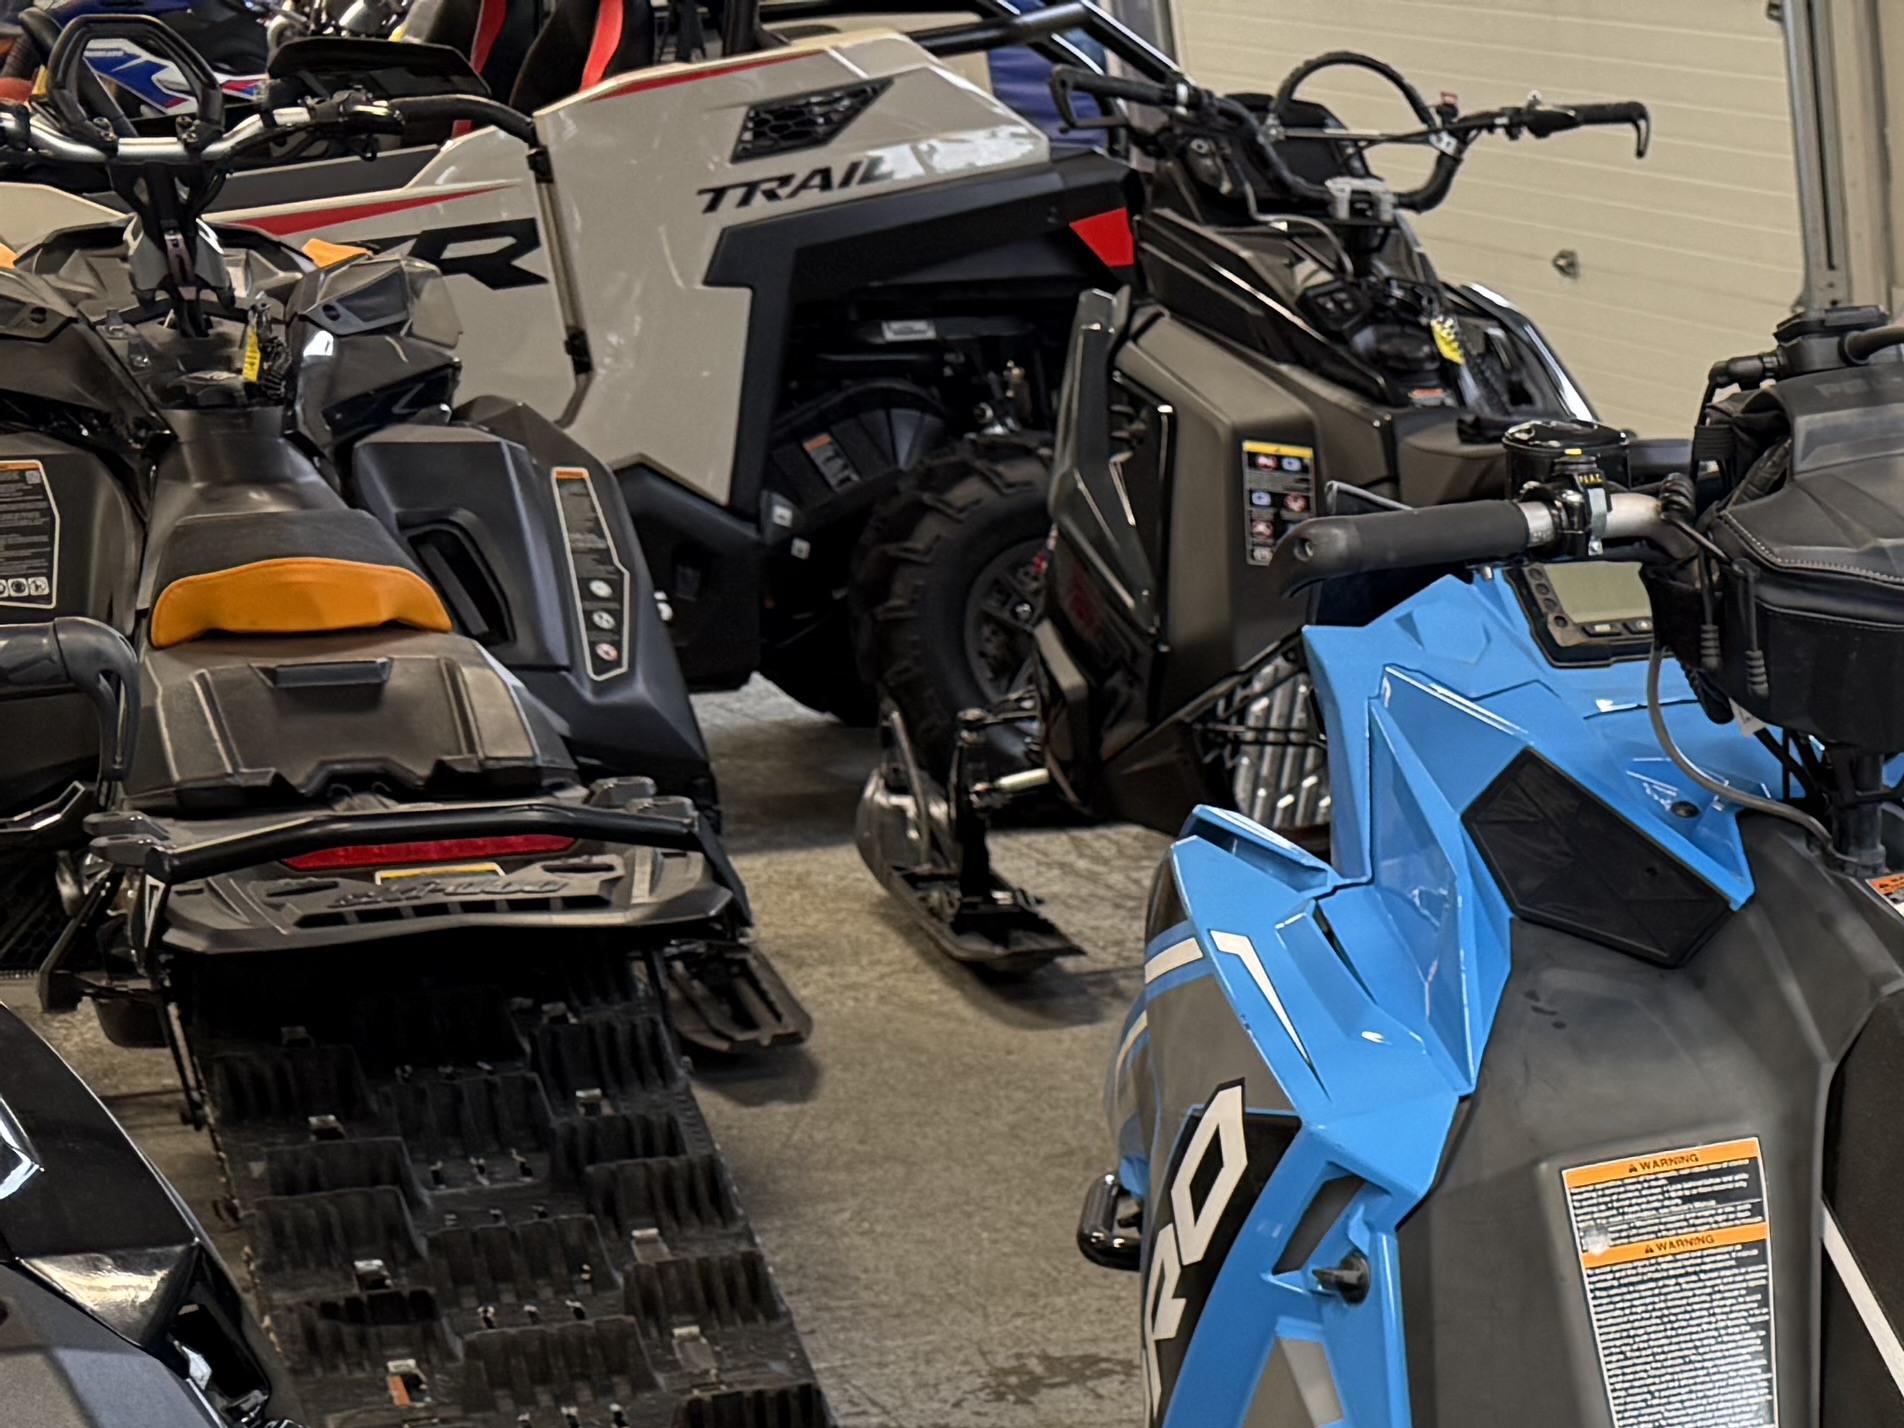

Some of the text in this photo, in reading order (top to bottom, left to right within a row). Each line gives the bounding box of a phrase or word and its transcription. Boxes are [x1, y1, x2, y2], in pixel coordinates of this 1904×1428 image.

[697, 156, 894, 214] TRAIL
[1639, 1153, 1699, 1171] WARNING
[1655, 1234, 1715, 1252] WARNING
